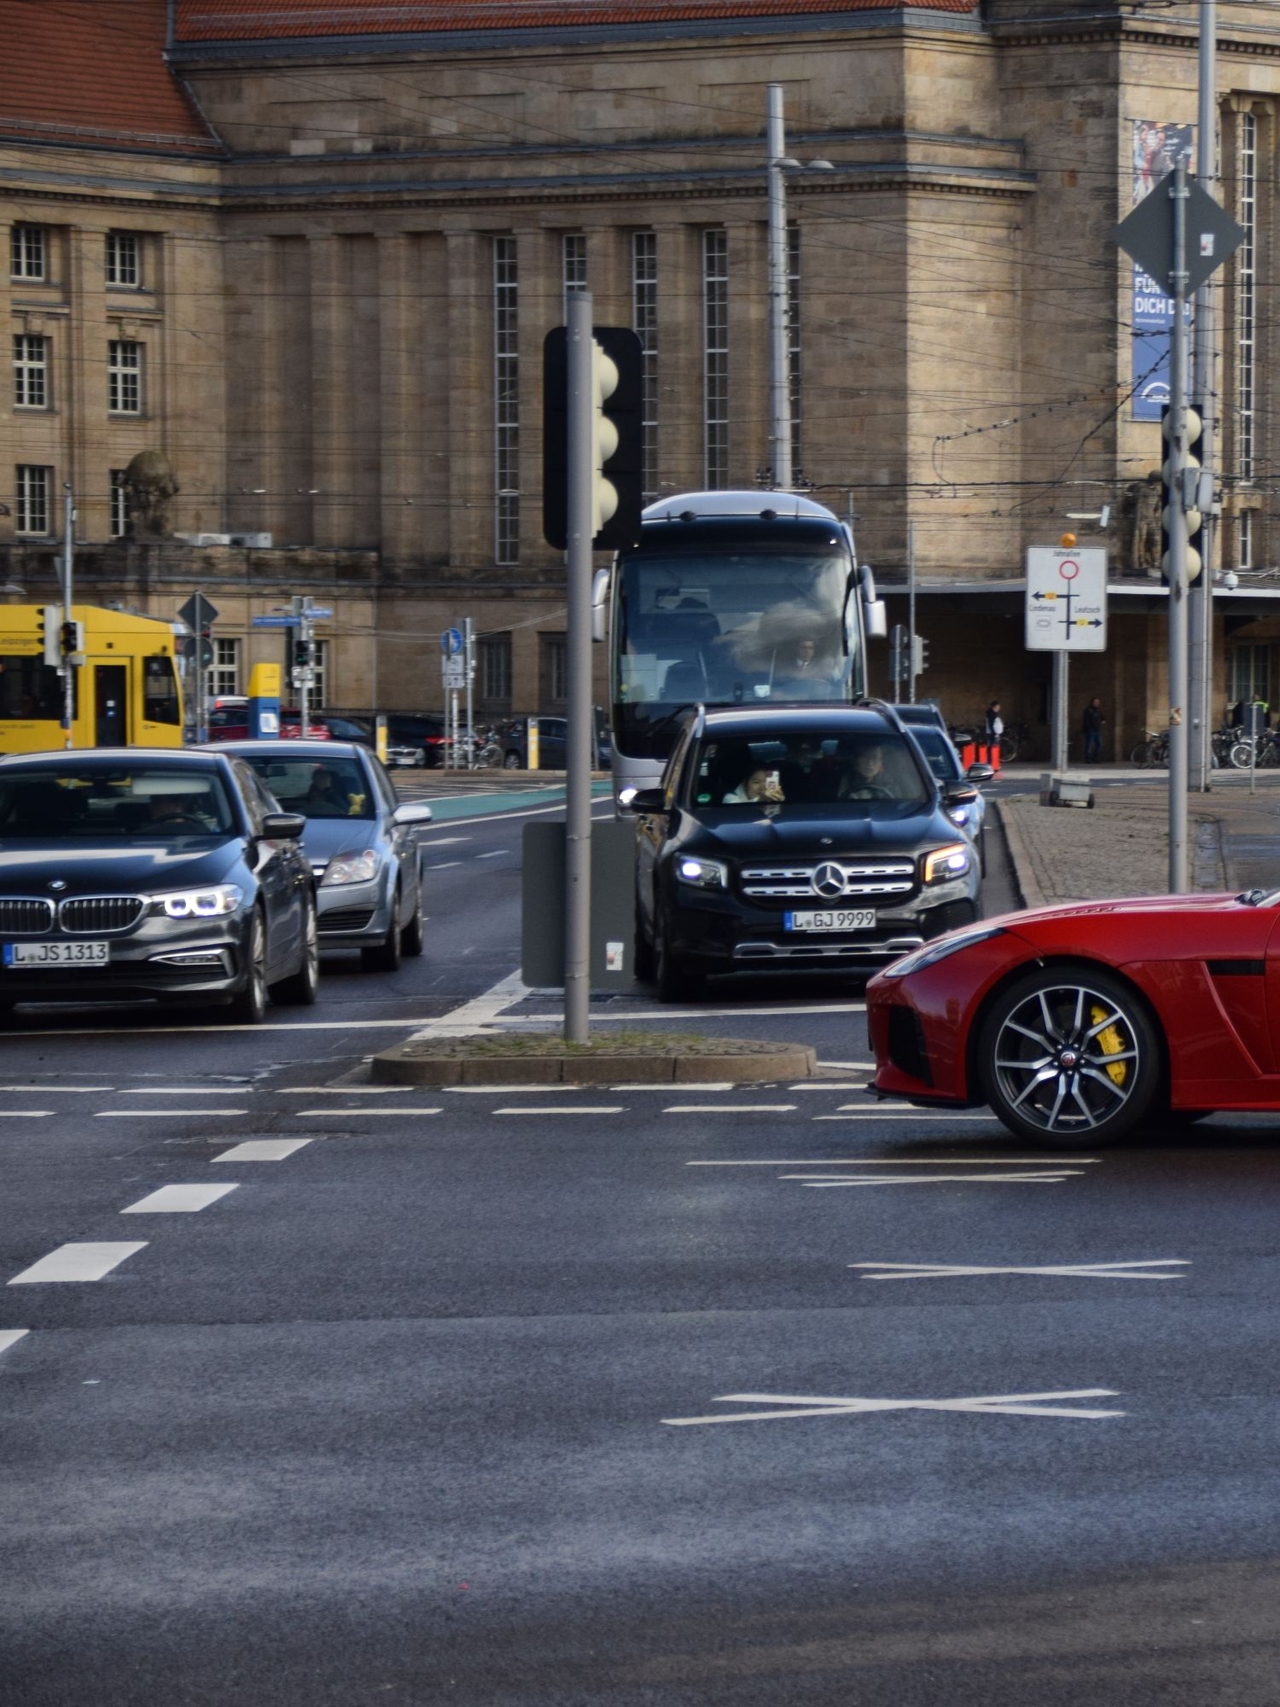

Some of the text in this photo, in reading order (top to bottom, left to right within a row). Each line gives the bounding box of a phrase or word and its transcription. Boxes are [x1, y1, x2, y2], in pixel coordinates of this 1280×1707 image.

[1134, 297, 1166, 315] DICH
[794, 911, 874, 928] L GJ 9999
[14, 944, 106, 961] L JS 1313
